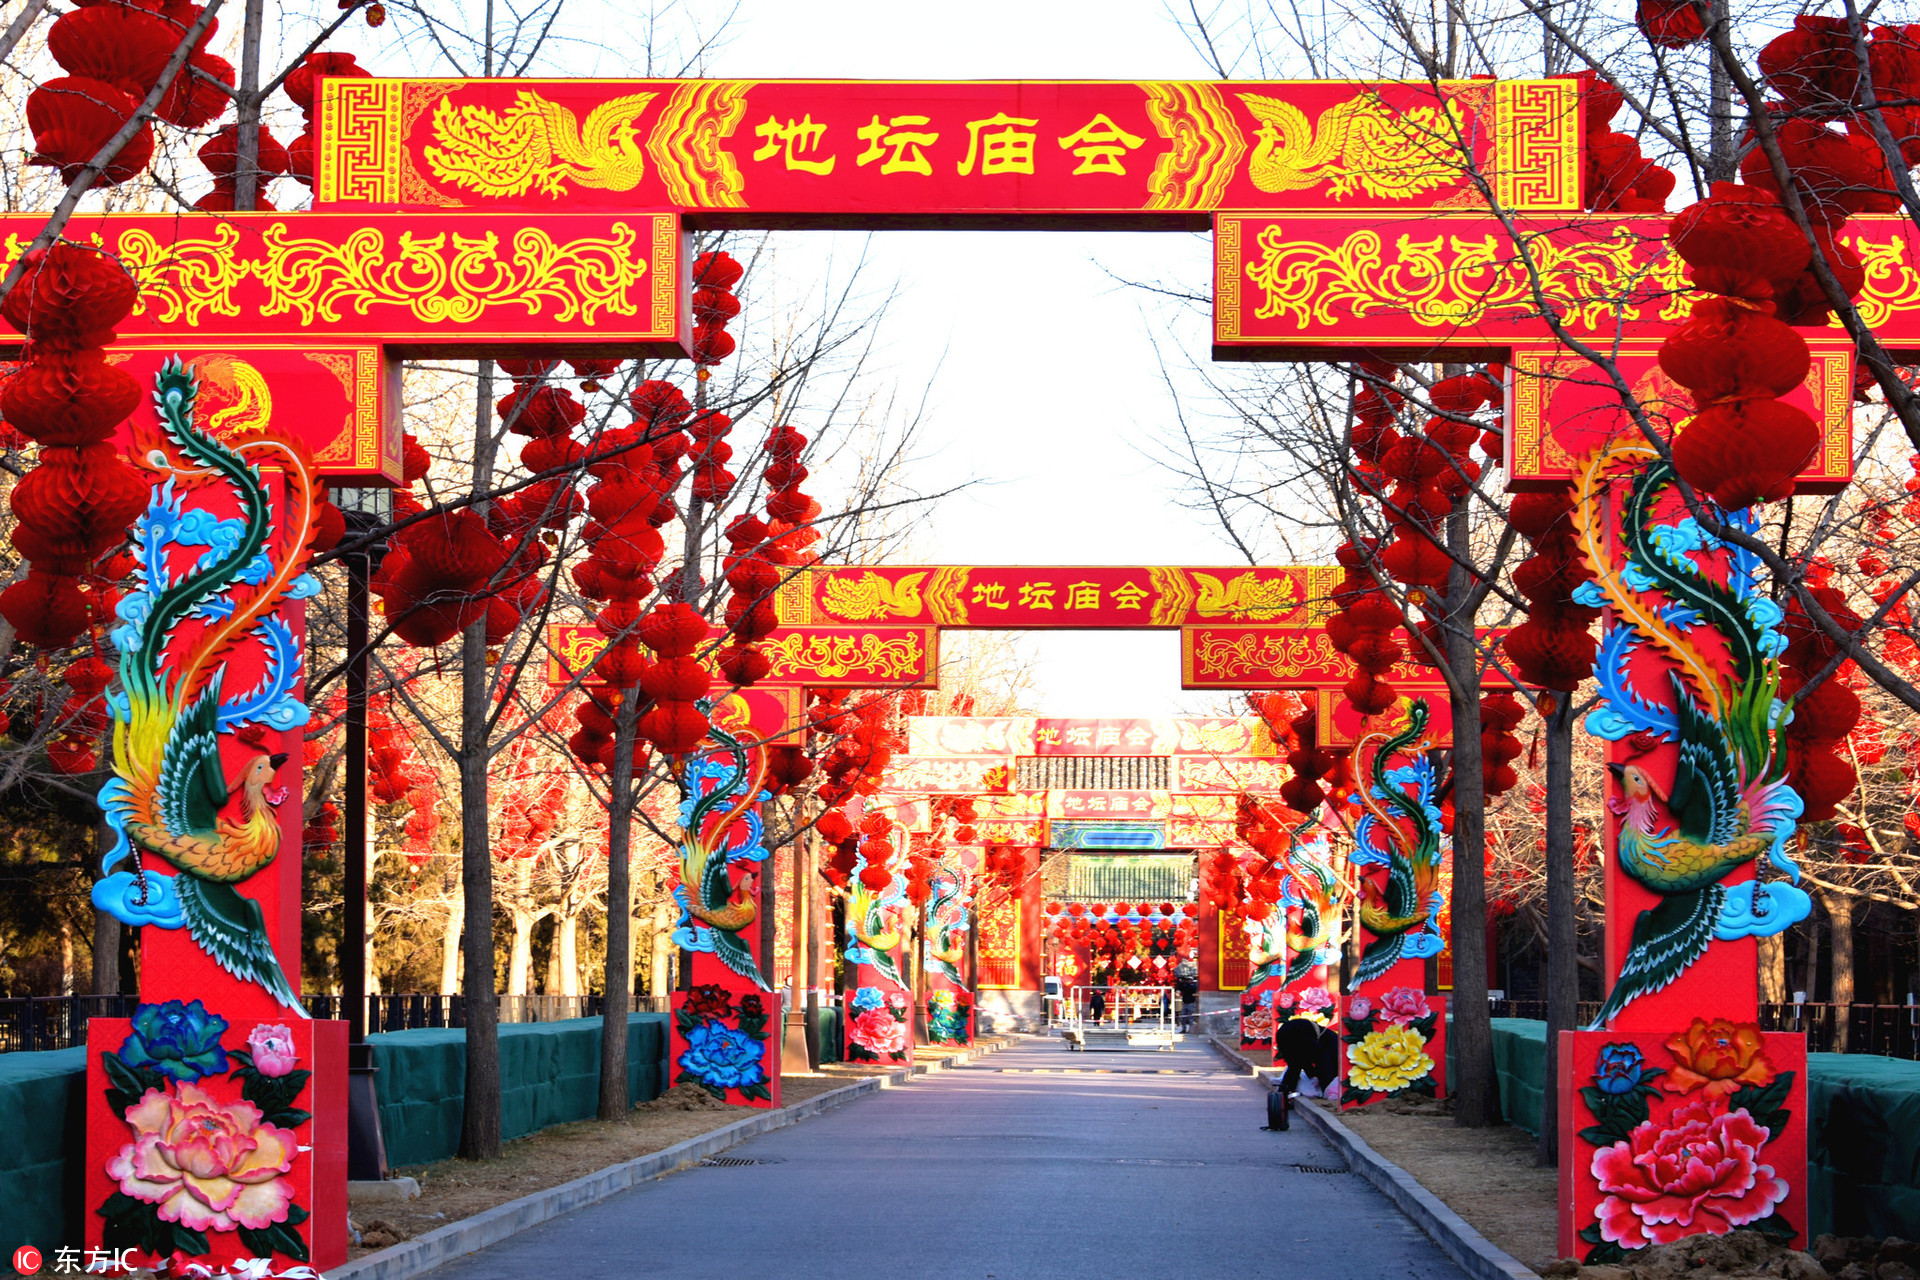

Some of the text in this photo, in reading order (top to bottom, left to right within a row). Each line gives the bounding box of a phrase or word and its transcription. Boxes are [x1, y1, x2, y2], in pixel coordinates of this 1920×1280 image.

[753, 112, 1146, 176] 地坛庙会
[971, 580, 1149, 610] 地坛庙会
[1037, 727, 1152, 746] 地坛庙会
[1065, 796, 1151, 811] 地坛庙会
[1055, 954, 1078, 976] 福
